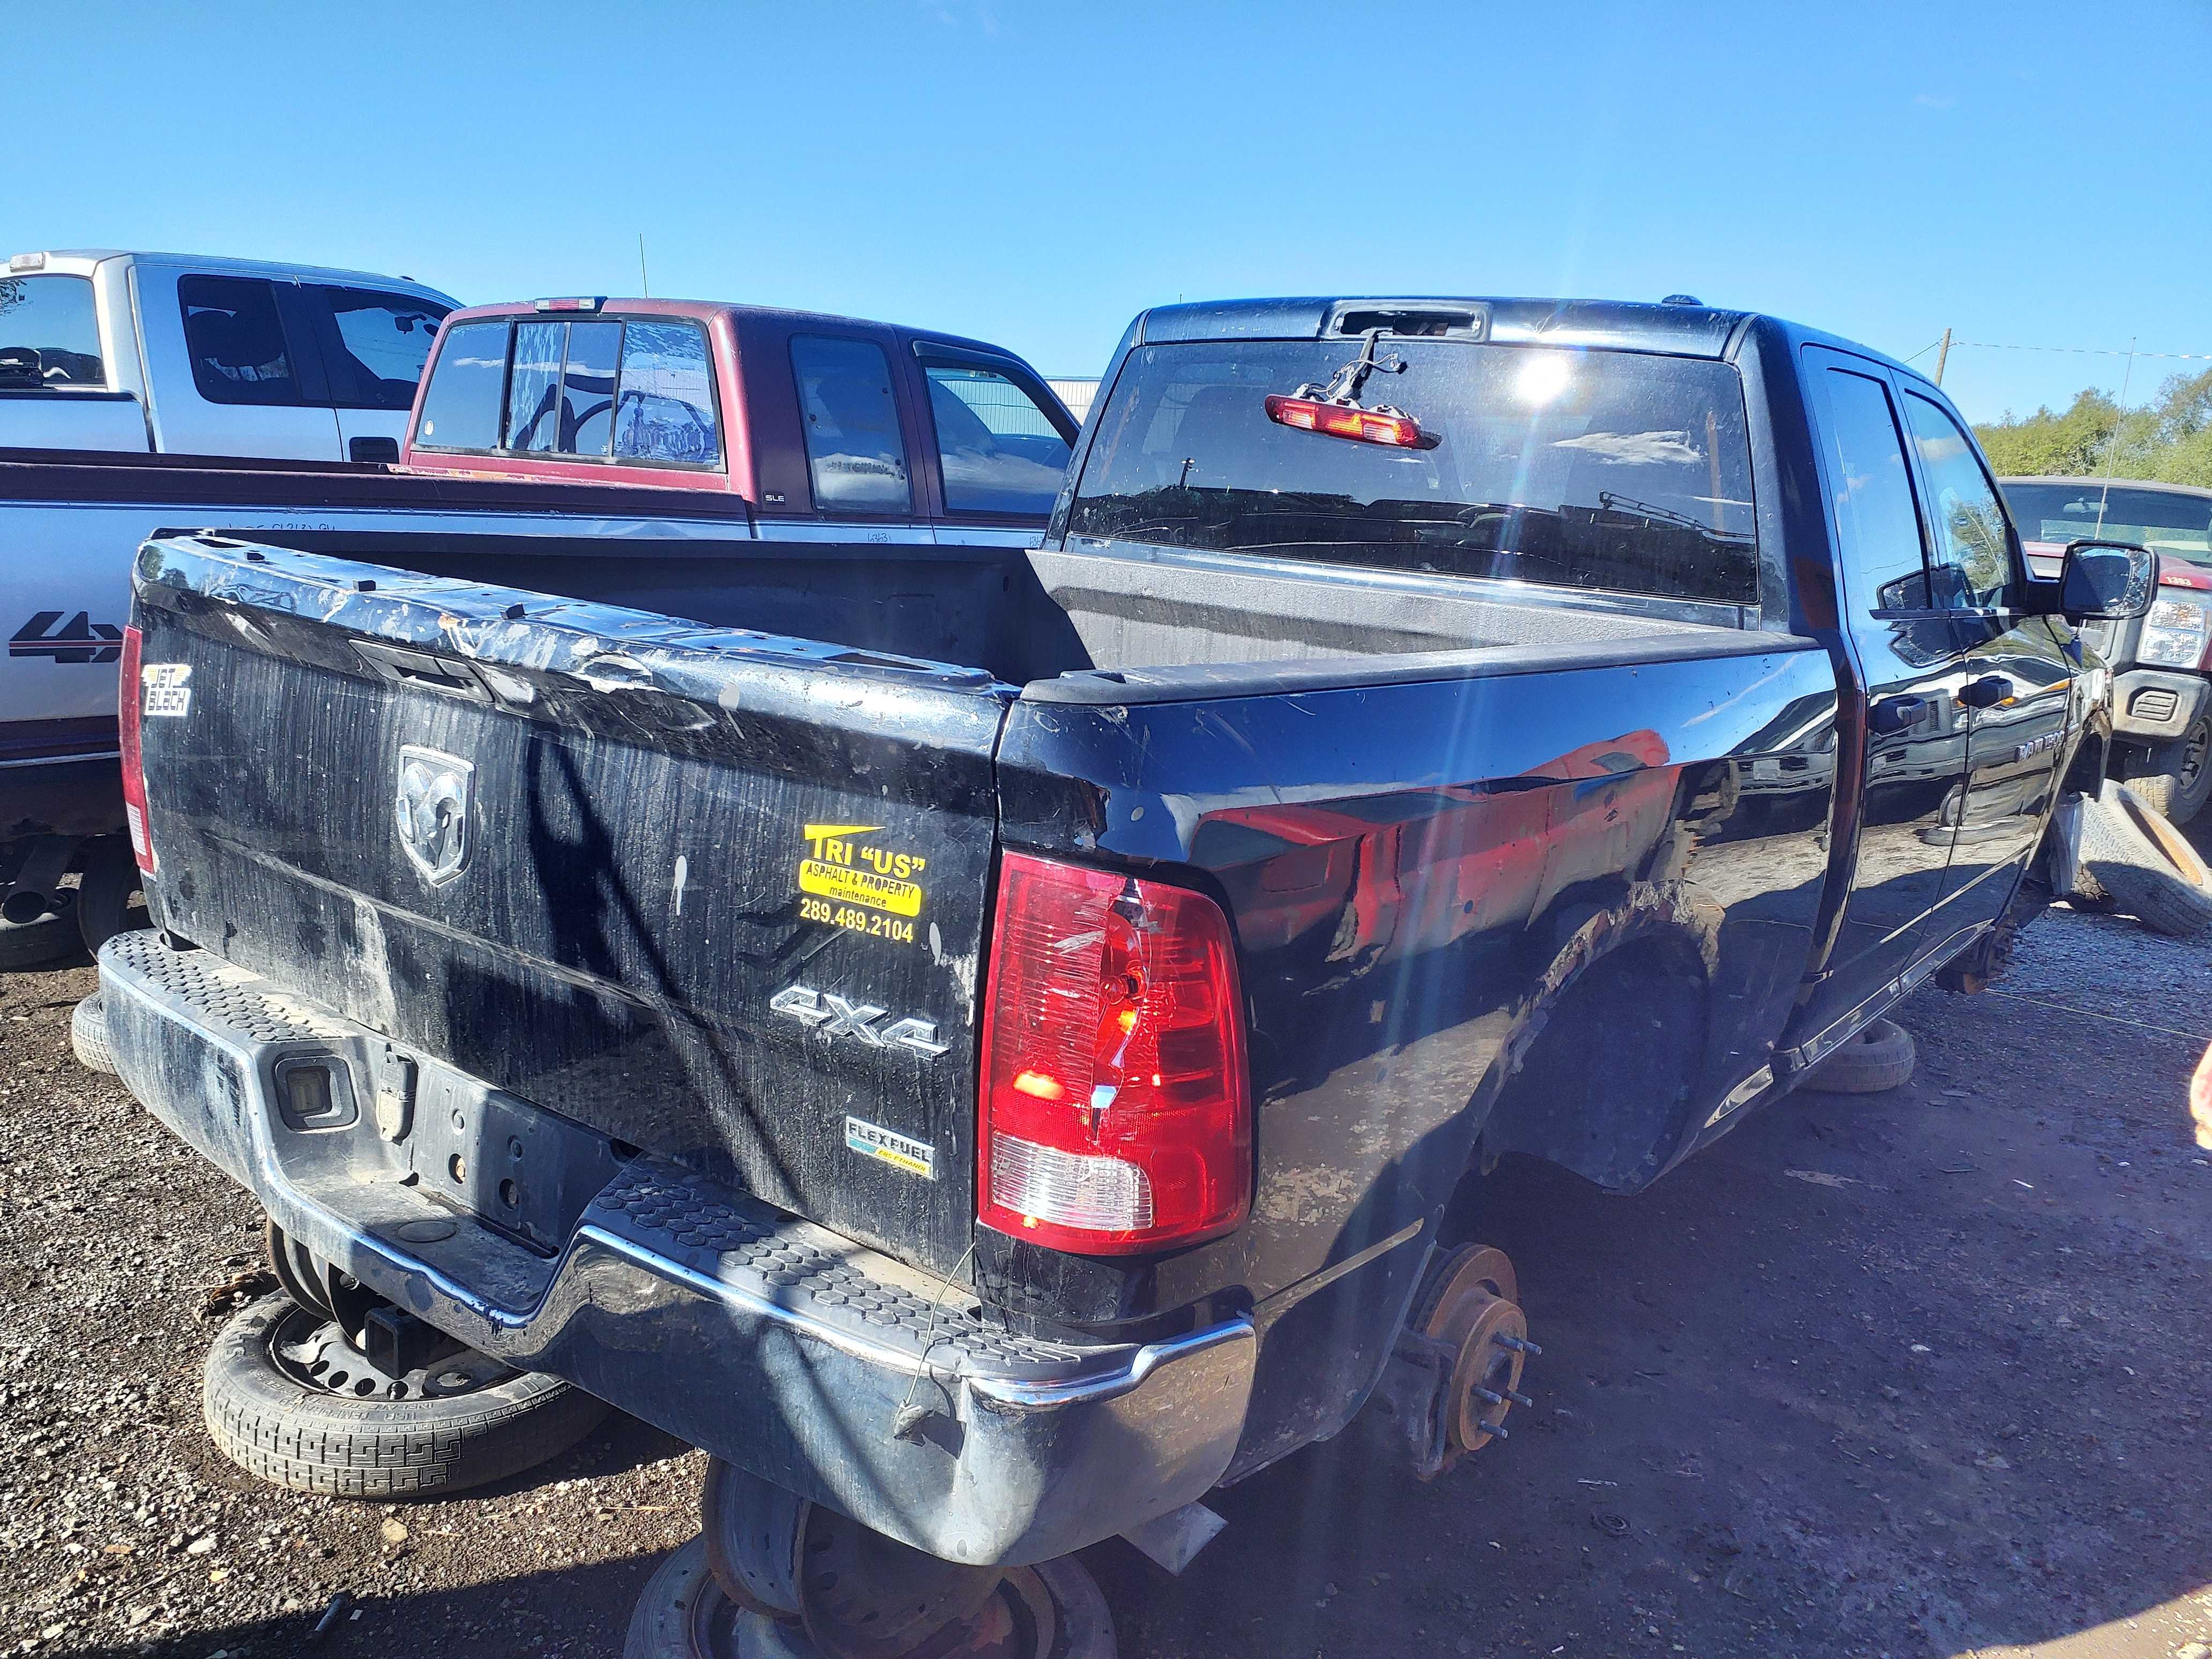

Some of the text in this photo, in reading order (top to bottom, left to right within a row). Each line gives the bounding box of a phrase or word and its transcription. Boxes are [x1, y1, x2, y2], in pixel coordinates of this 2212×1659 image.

[2017, 737, 2045, 761] RAM
[804, 824, 886, 866] TRI
[806, 863, 915, 899] ASPHALT & PROPERTY
[829, 887, 886, 907] maintenance
[799, 898, 914, 943] 289.489.2104
[770, 985, 951, 1062] 4X4
[849, 1122, 931, 1162] FLEXFUEL
[894, 1156, 927, 1171] ETHANOL
